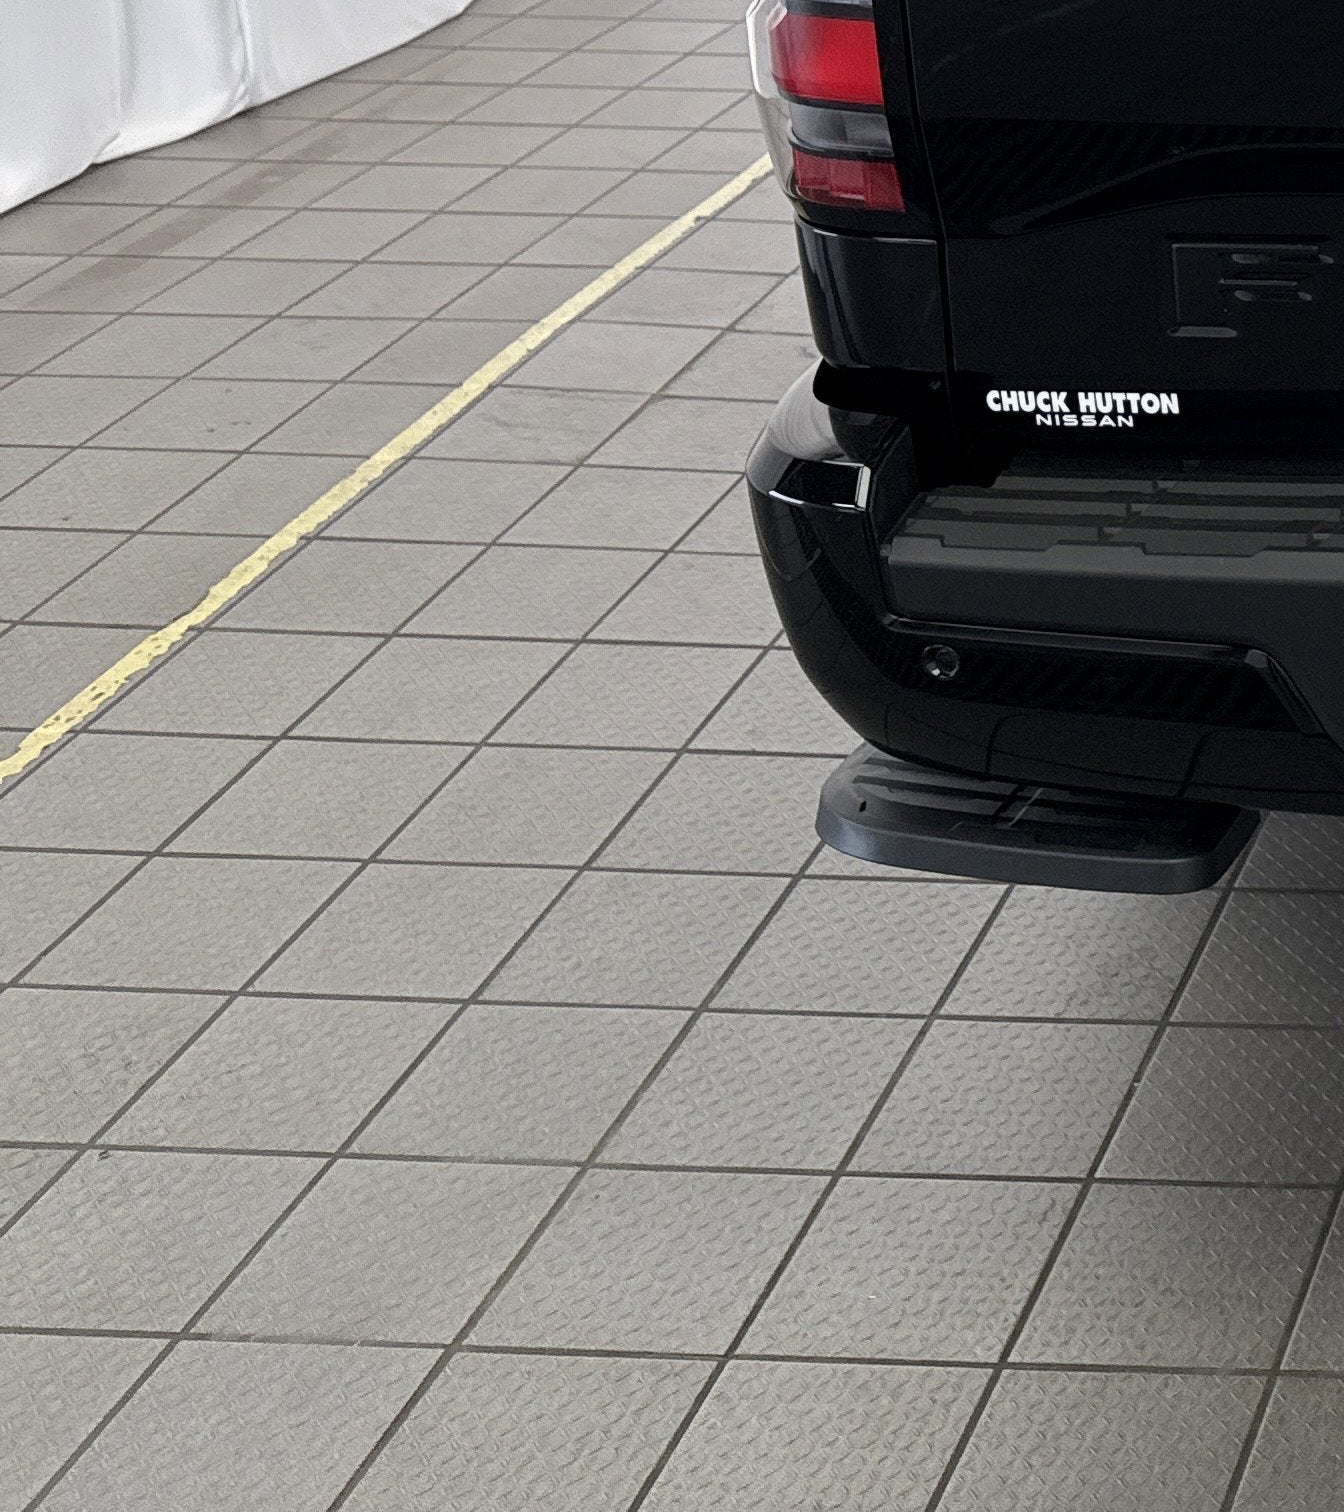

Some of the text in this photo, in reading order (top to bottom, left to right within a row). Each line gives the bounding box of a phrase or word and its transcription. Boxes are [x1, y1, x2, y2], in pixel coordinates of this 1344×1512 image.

[986, 390, 1180, 414] CHUCK HUTTON
[1036, 414, 1134, 428] NISSAN
